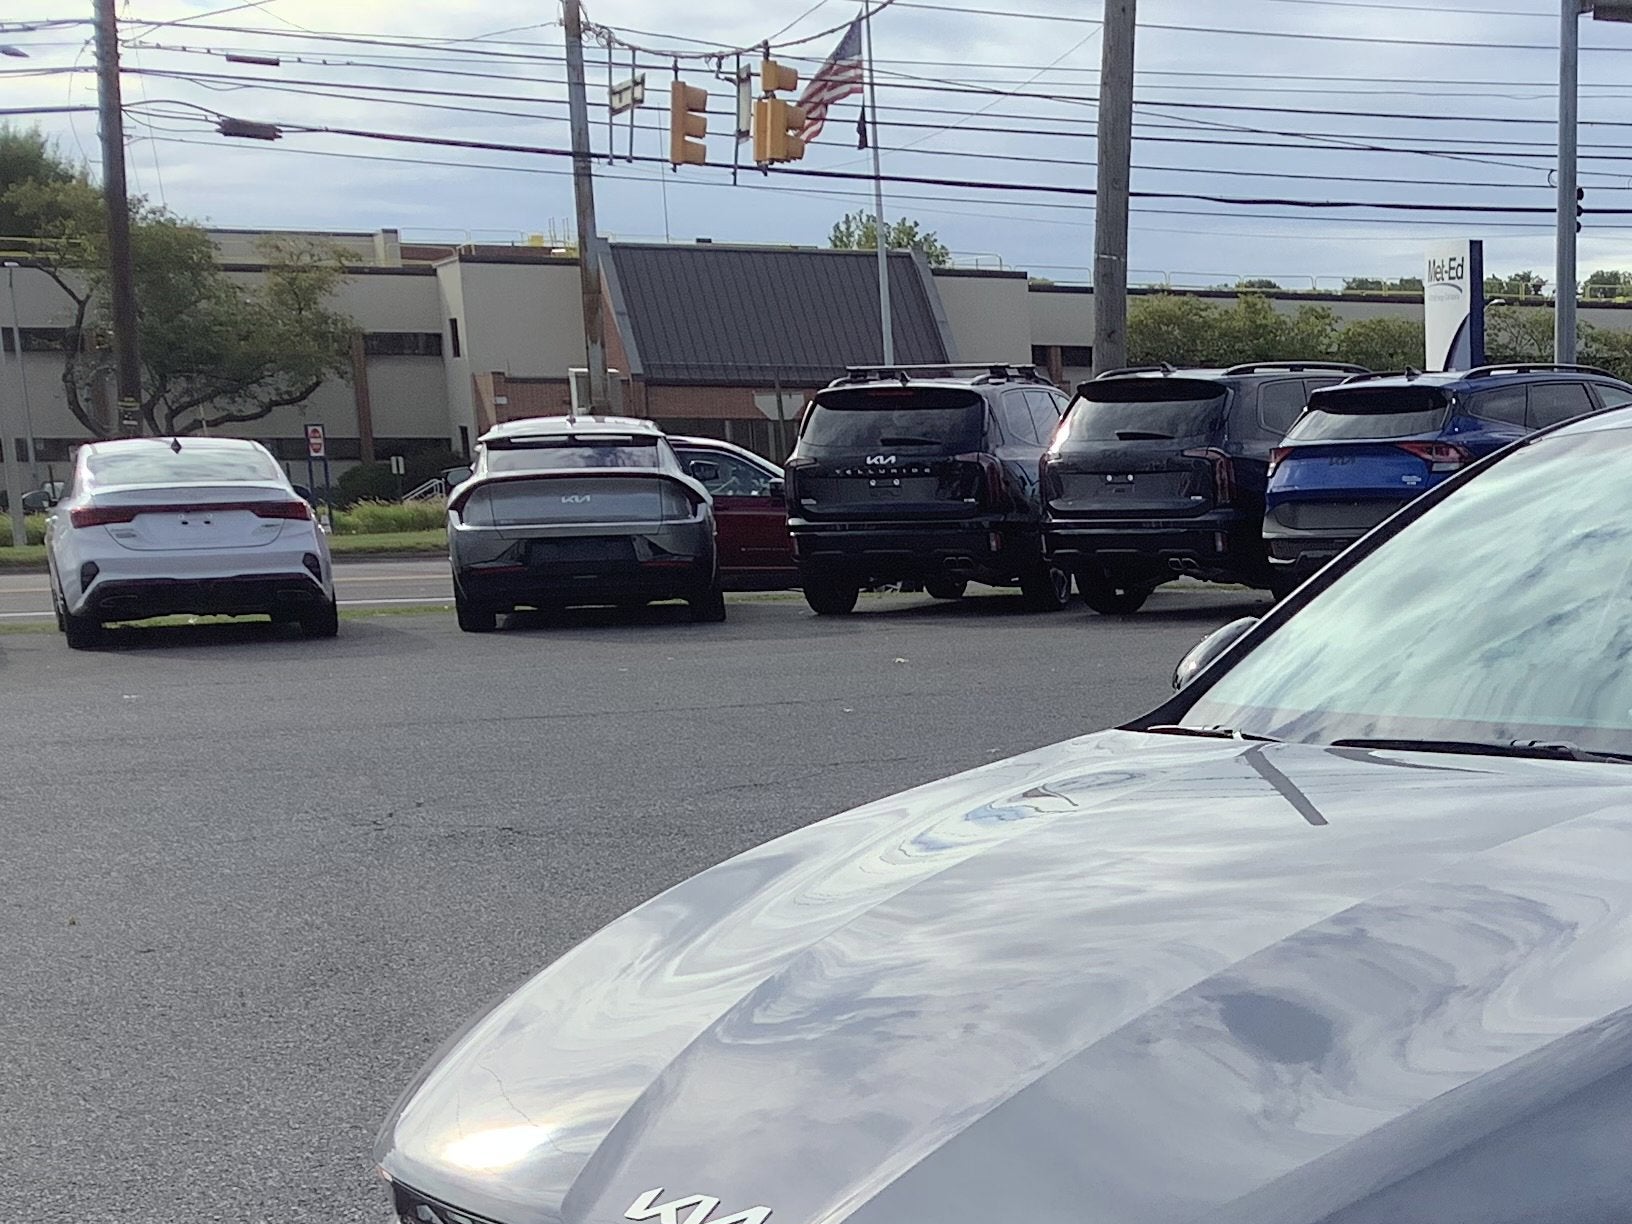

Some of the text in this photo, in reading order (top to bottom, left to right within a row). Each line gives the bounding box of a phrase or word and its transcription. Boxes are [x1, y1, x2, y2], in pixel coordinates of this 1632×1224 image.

[1427, 256, 1464, 282] Met-Ed
[866, 456, 896, 465] KIA
[561, 495, 591, 503] KIA
